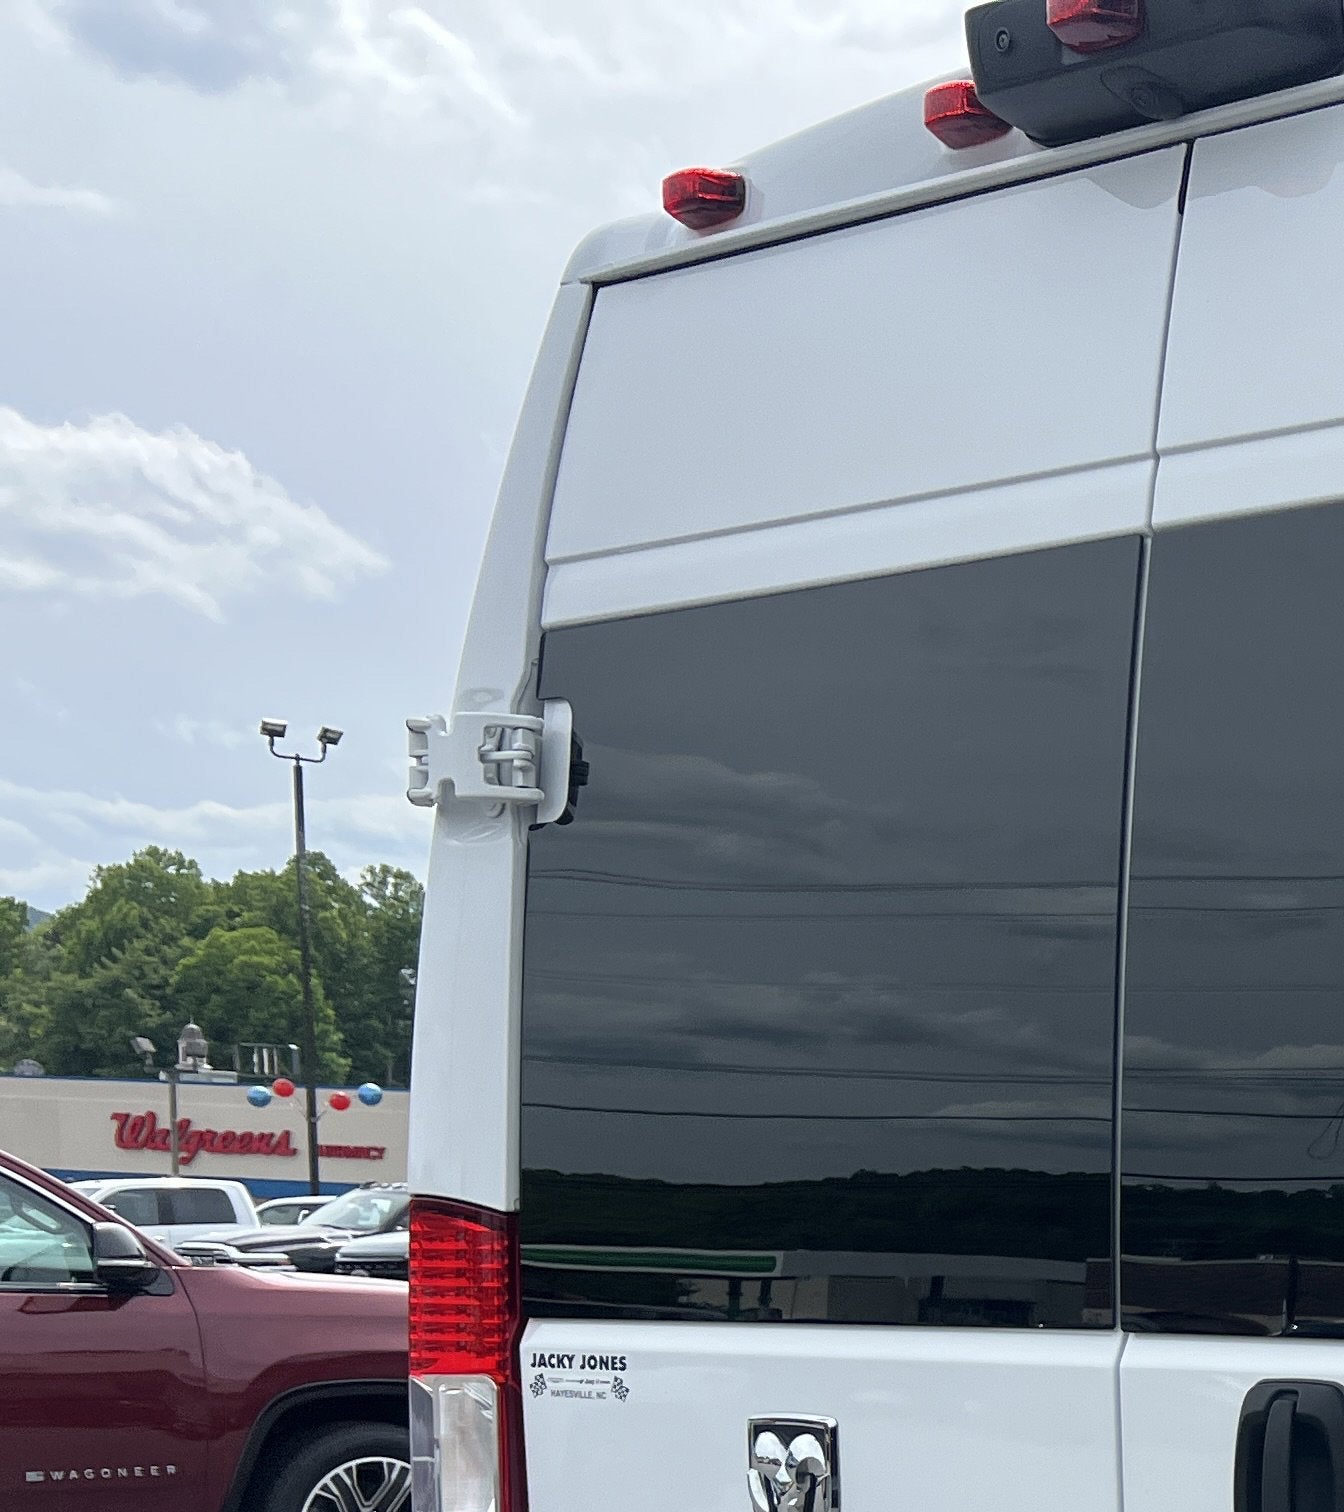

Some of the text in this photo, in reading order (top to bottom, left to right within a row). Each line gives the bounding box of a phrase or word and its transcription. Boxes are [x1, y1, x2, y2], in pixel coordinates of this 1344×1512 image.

[110, 1110, 298, 1166] Walgreens
[530, 1353, 627, 1371] JACKY JONES
[49, 1464, 178, 1481] WAGONEER
